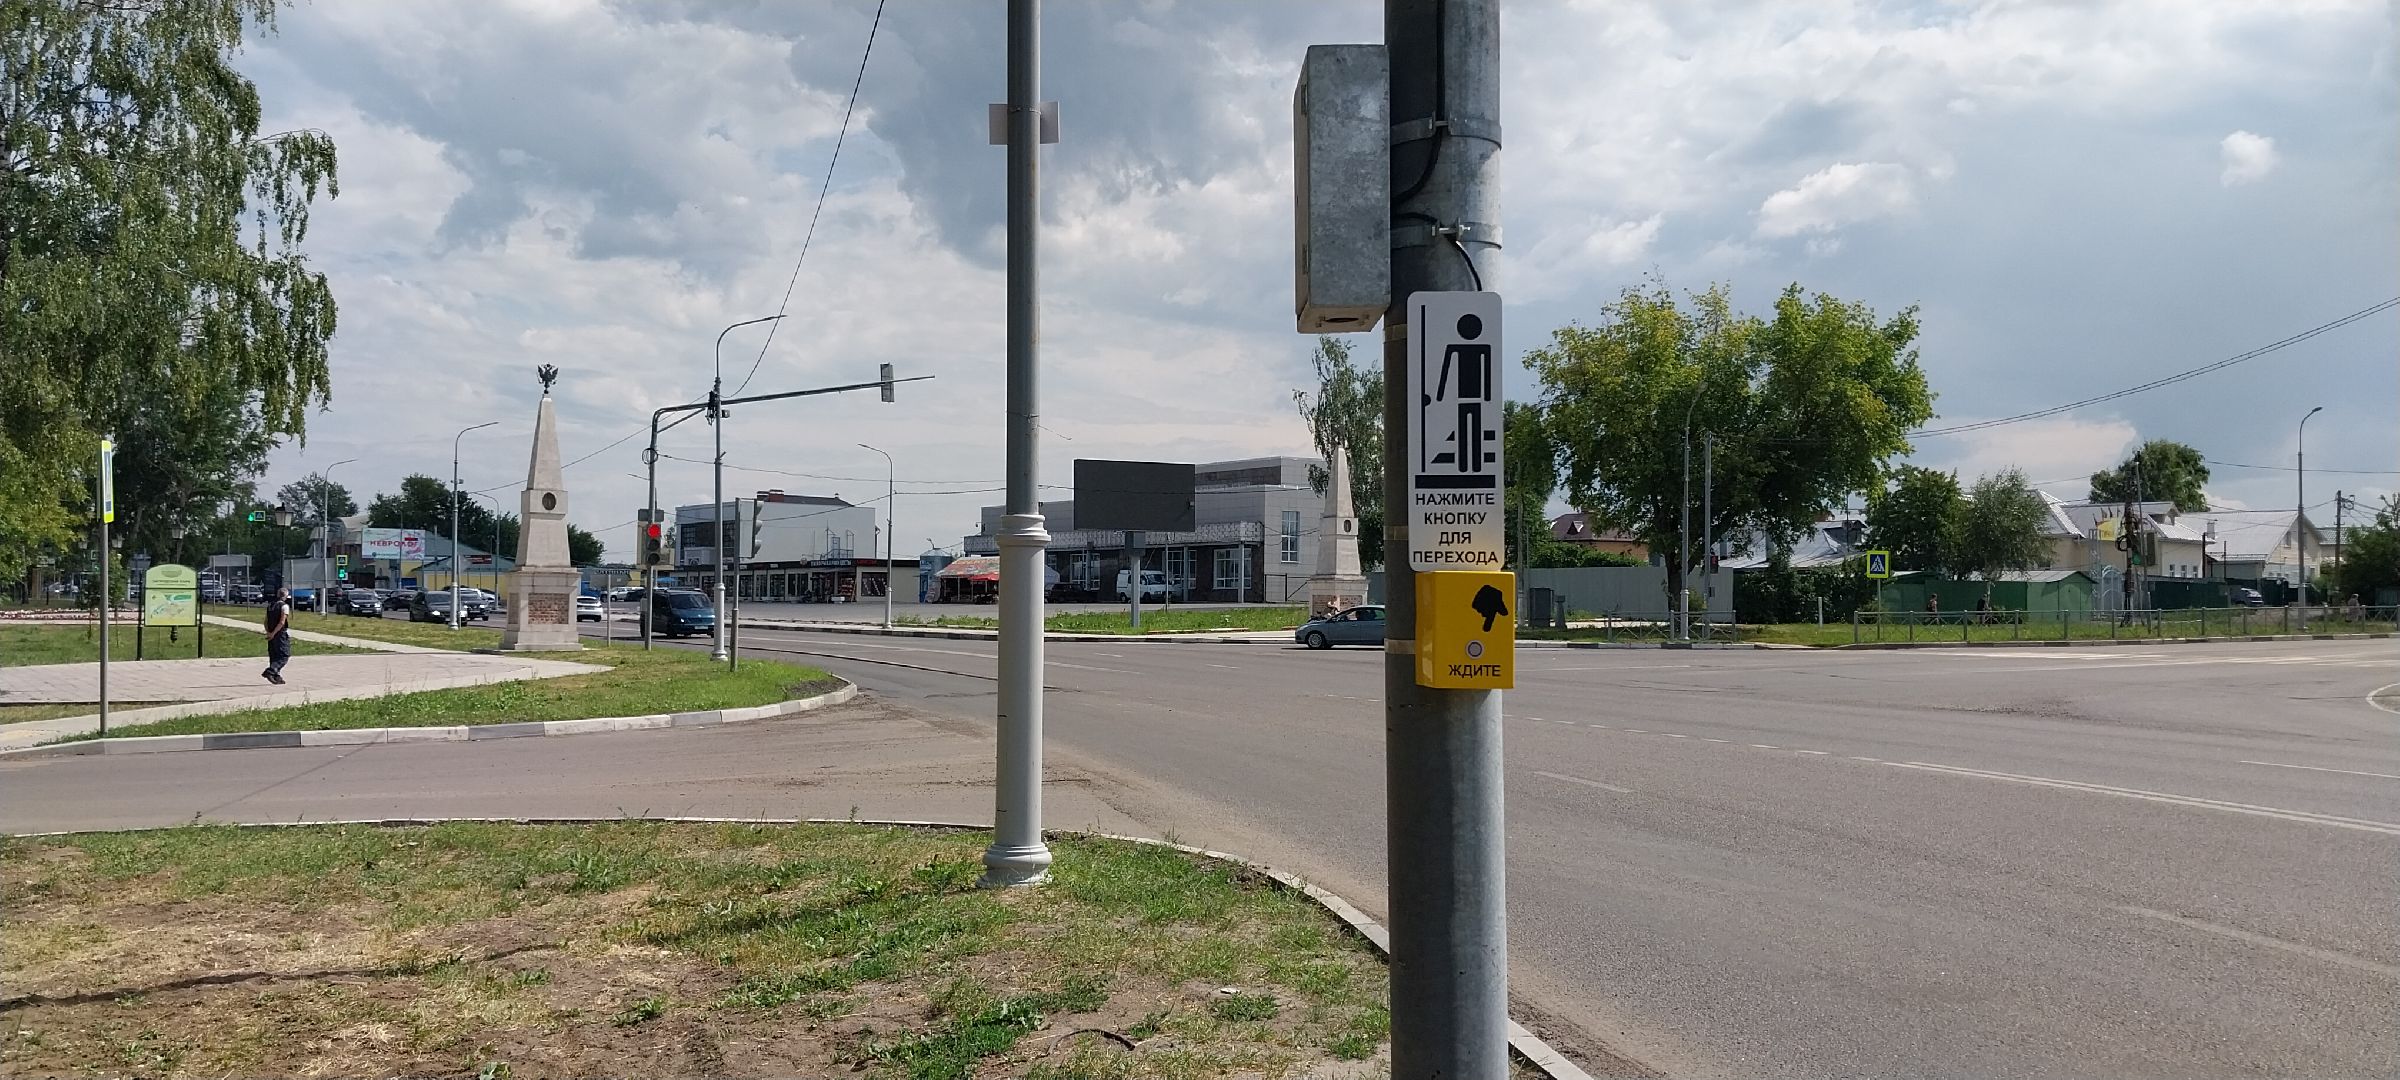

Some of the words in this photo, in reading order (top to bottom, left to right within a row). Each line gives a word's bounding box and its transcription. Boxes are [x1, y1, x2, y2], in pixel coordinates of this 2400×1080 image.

[1415, 493, 1496, 506] НАЖМИТЕ
[1424, 512, 1487, 525] КНОПКУ
[1438, 531, 1471, 547] ДЛЯ
[1413, 551, 1498, 566] ПЕРЕХОДА
[1448, 664, 1501, 678] ЖДИТЕ
